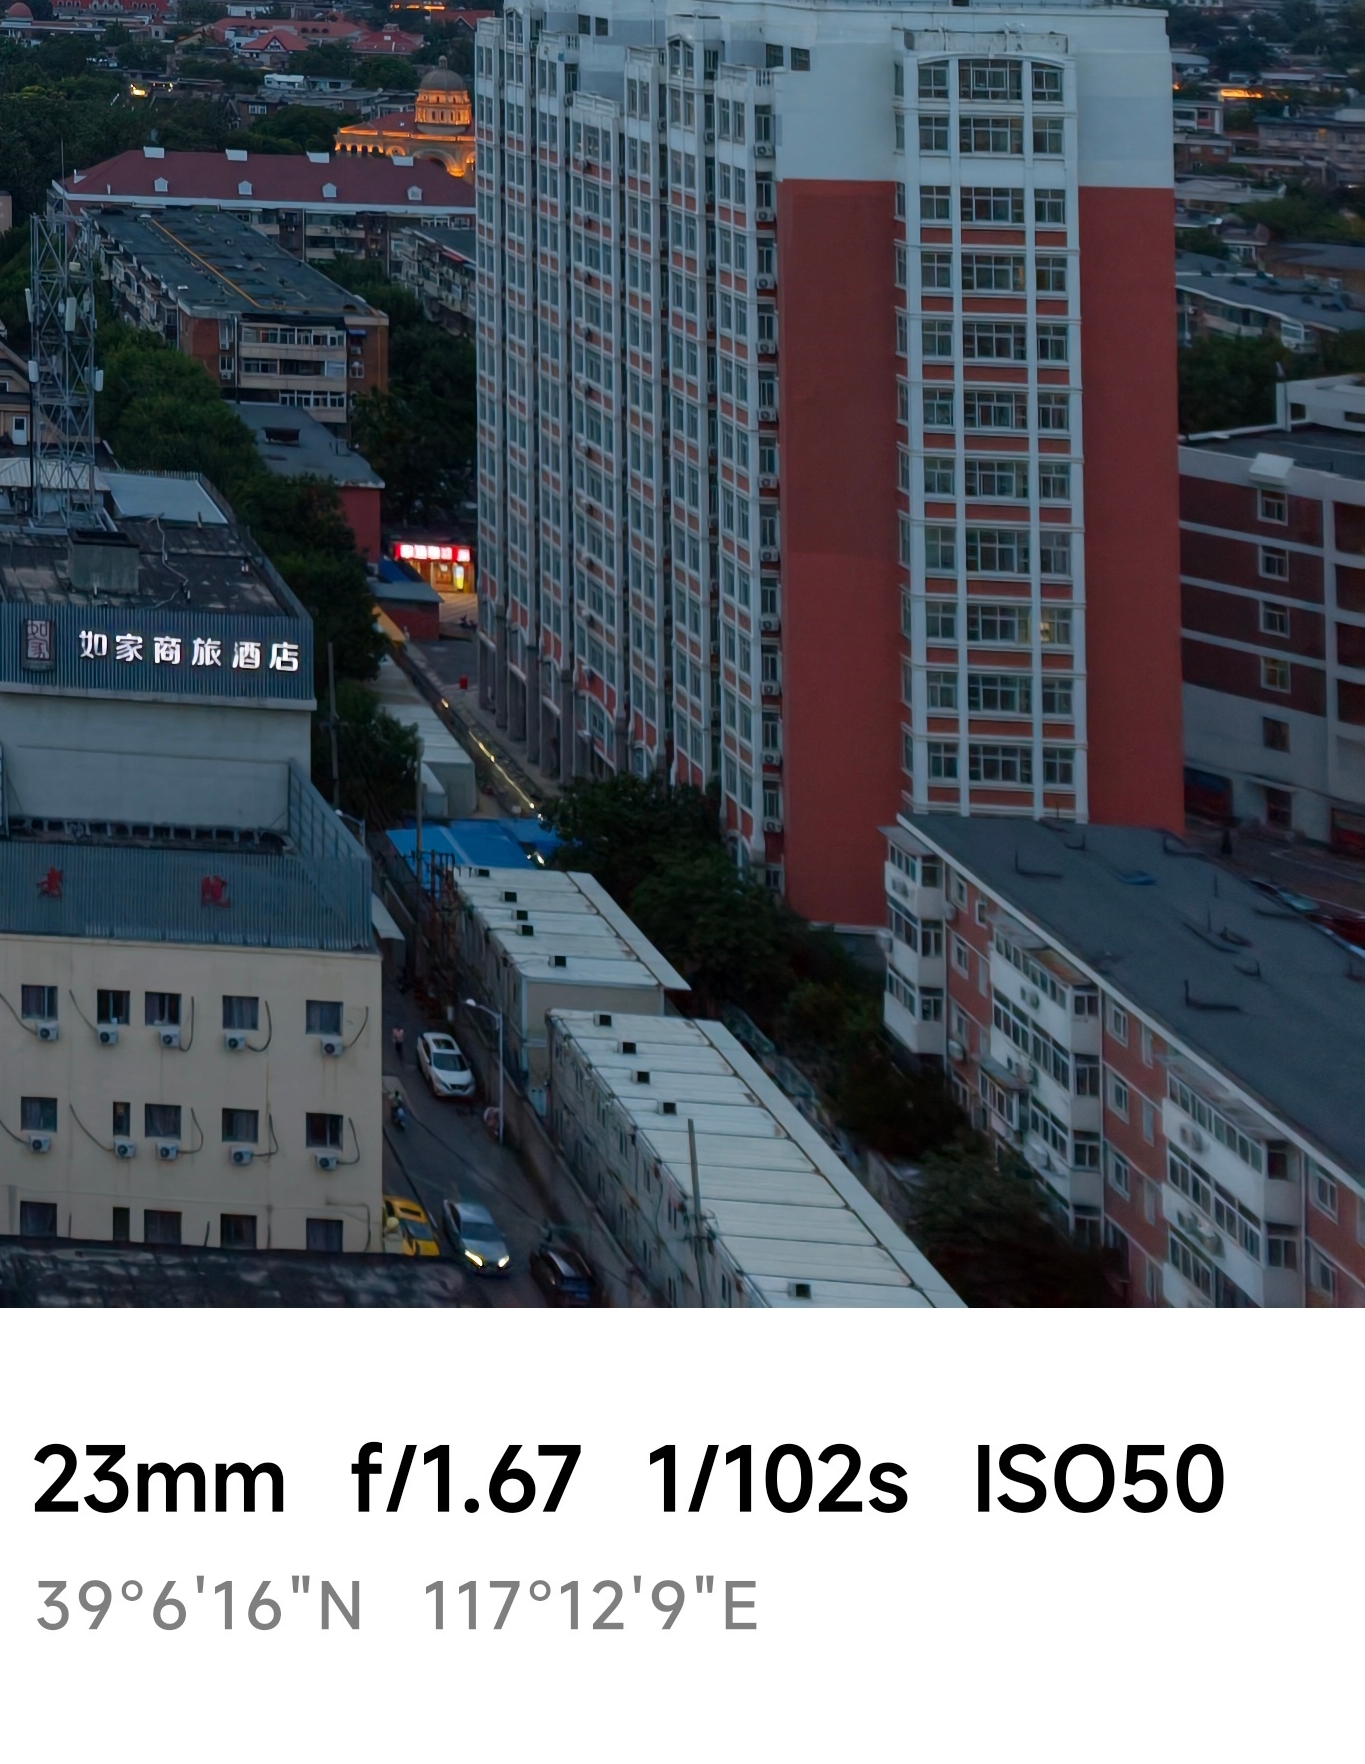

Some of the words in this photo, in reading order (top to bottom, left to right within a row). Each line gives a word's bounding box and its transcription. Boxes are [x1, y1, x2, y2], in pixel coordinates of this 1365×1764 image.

[79, 630, 299, 672] 如家商旅酒店
